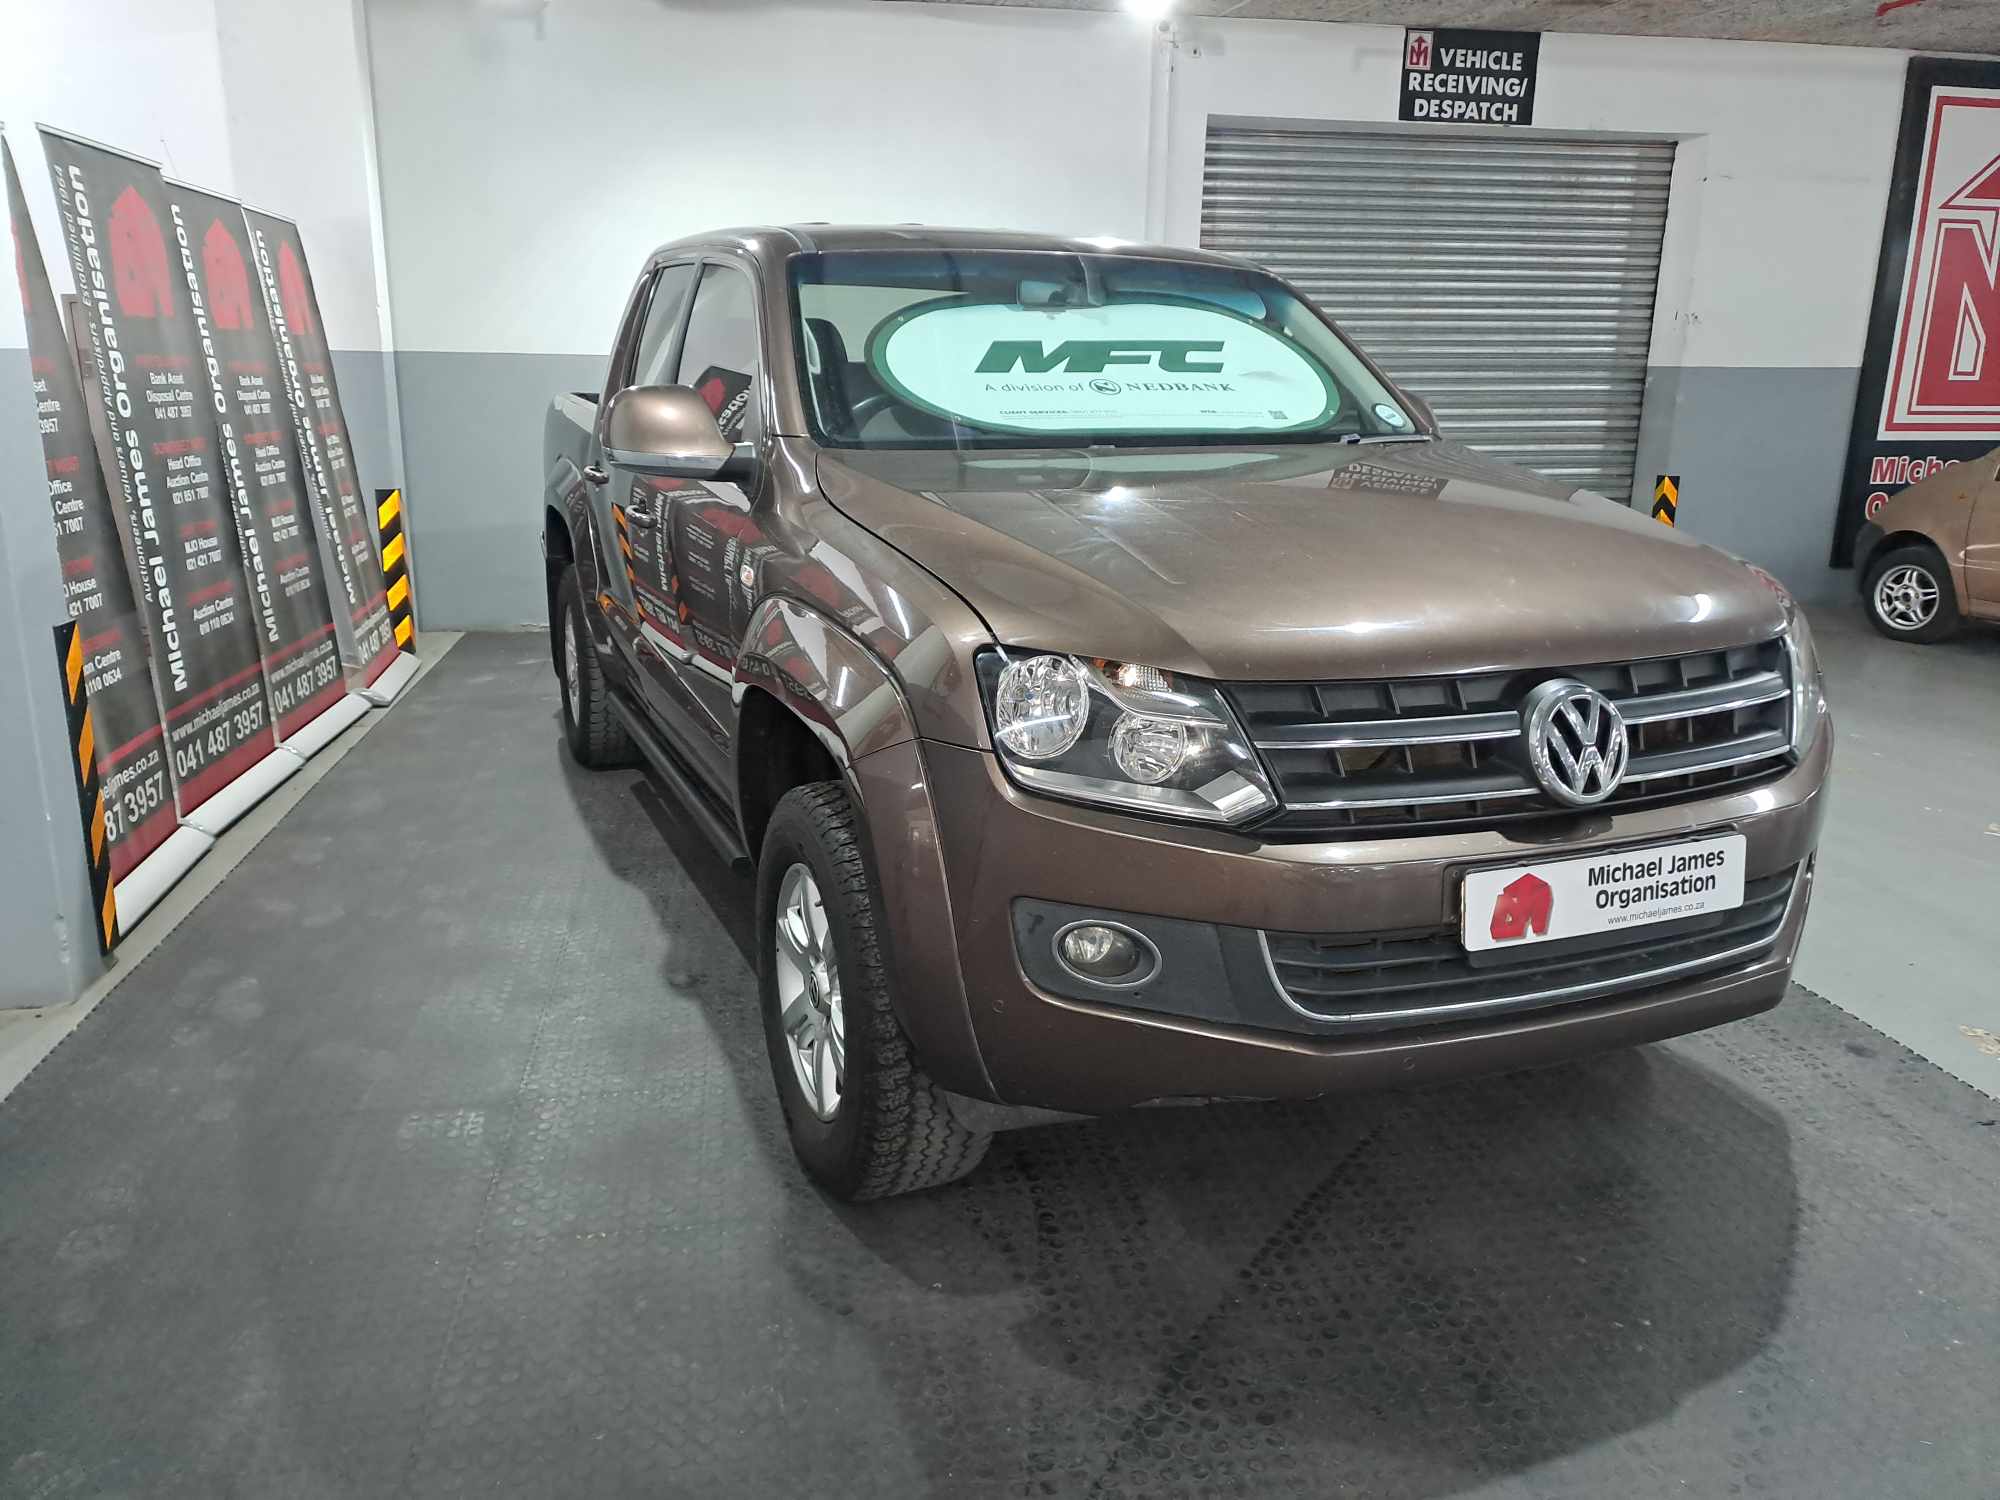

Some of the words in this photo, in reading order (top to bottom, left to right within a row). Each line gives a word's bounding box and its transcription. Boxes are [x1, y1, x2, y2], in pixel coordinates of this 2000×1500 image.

[1440, 47, 1523, 71] VEHICLE
[1408, 72, 1528, 98] RECEIVING/
[1413, 98, 1518, 122] DESPATCH
[68, 165, 132, 418] Organisation
[171, 204, 227, 414] Organisation
[255, 230, 305, 409] Organisation
[974, 340, 1225, 373] MFC
[984, 383, 995, 392] A
[1001, 383, 1065, 393] division
[1068, 383, 1084, 392] of
[1126, 382, 1236, 393] NEDBANK
[107, 410, 120, 442] and
[222, 423, 252, 520] James
[1870, 455, 1960, 485] Mich
[125, 429, 160, 546] James
[55, 499, 84, 516] Centre
[64, 517, 84, 534] 7007
[70, 578, 97, 595] House
[245, 528, 279, 642] Michael
[84, 593, 103, 612] 7007
[149, 556, 188, 692] Michael
[94, 649, 121, 669] Centre
[274, 683, 295, 714] 041
[296, 670, 315, 699] 487
[315, 656, 337, 687] 3957
[176, 739, 205, 778] 041
[207, 720, 231, 757] 487
[234, 700, 264, 740] 3957
[104, 802, 124, 842] 87
[124, 770, 163, 823] 3957
[1588, 857, 1662, 887] Michael
[1667, 849, 1725, 875] James
[1595, 874, 1716, 909] Organisation
[1607, 901, 1705, 925] www.michaeljames.co.za
